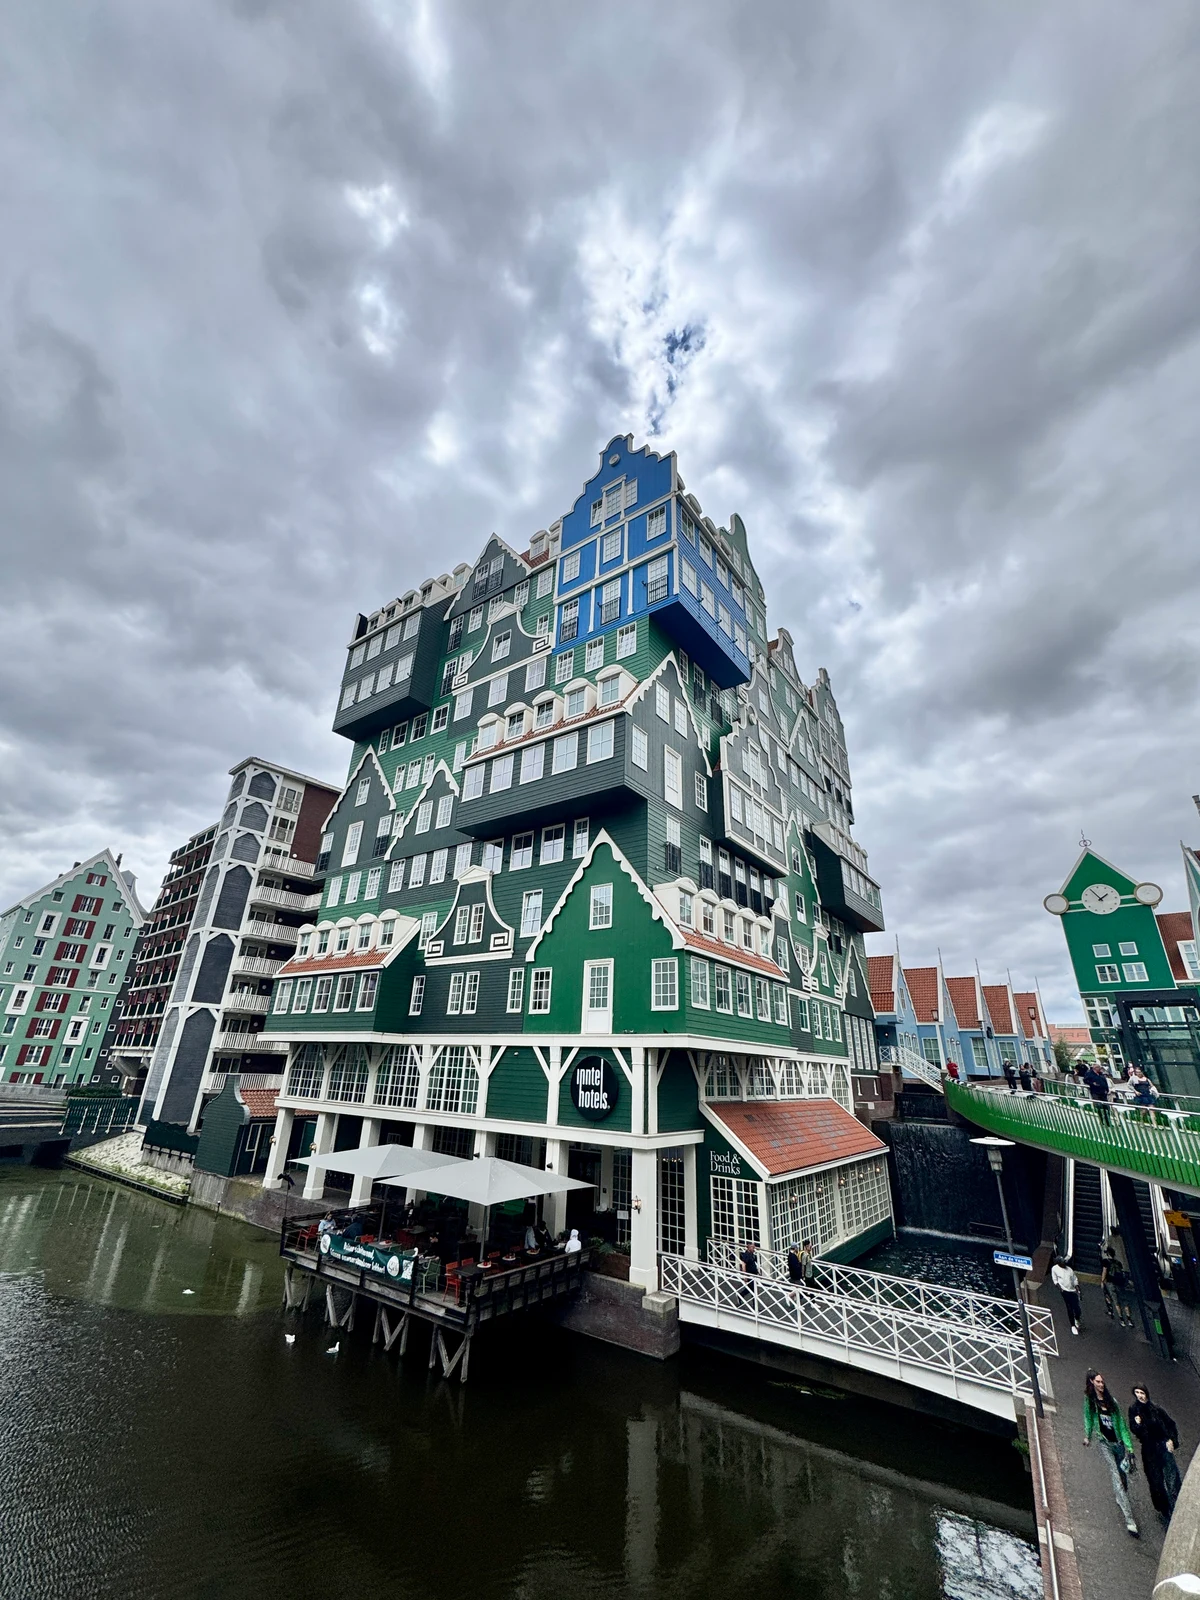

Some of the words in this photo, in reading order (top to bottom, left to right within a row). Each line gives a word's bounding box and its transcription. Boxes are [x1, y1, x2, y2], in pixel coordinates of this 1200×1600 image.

[576, 1058, 604, 1087] inntel
[578, 1089, 608, 1110] hotels
[710, 1150, 730, 1163] Food
[732, 1153, 741, 1165] &
[710, 1161, 741, 1175] Drinks
